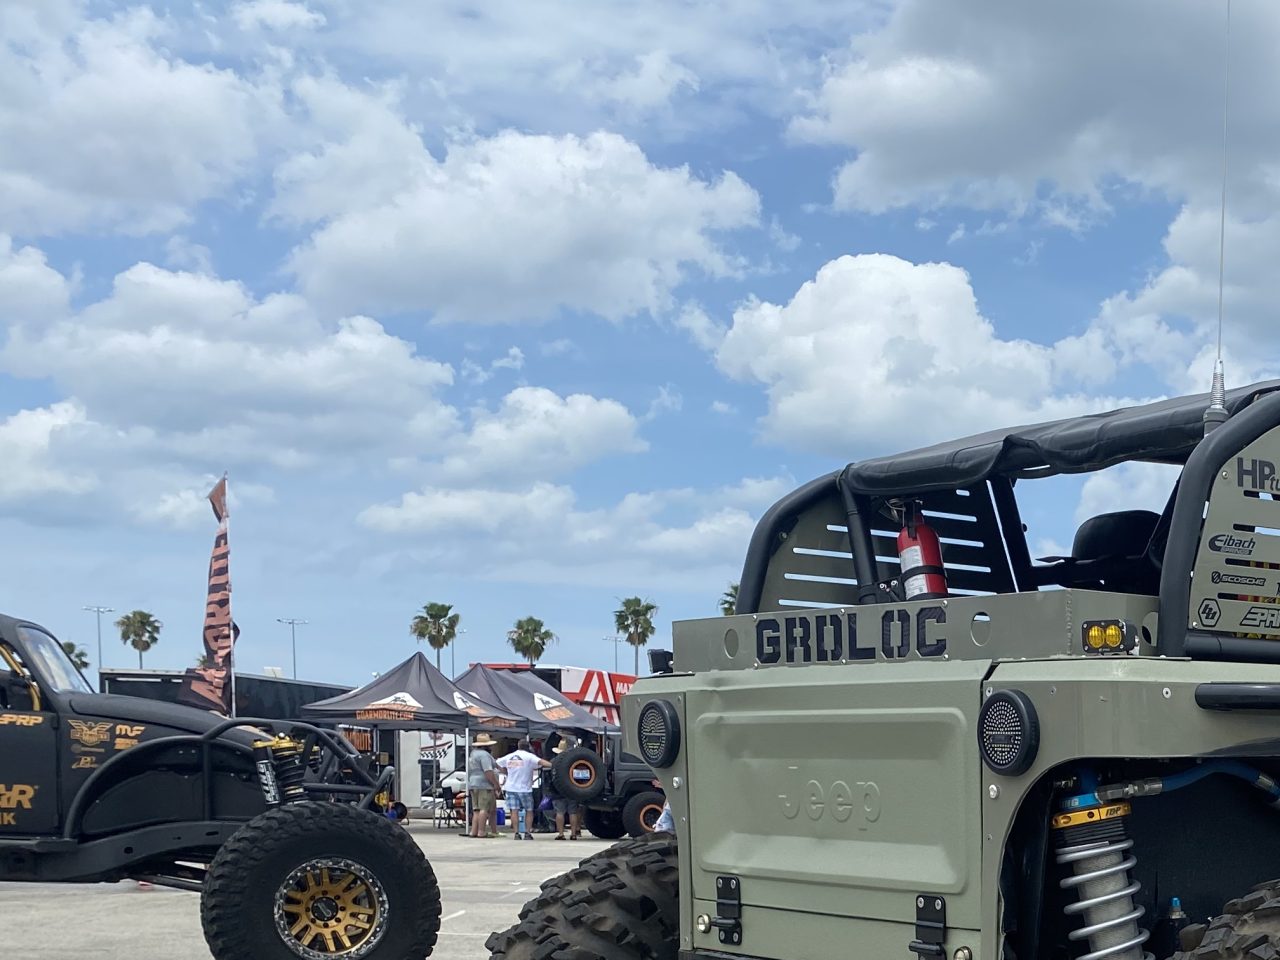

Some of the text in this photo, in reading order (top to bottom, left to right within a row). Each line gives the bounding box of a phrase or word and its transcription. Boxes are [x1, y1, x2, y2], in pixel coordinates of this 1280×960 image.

[1237, 457, 1276, 490] HP
[1208, 534, 1256, 553] Eibach
[1221, 574, 1266, 586] SCOSCHE
[755, 606, 947, 664] GRDLOC
